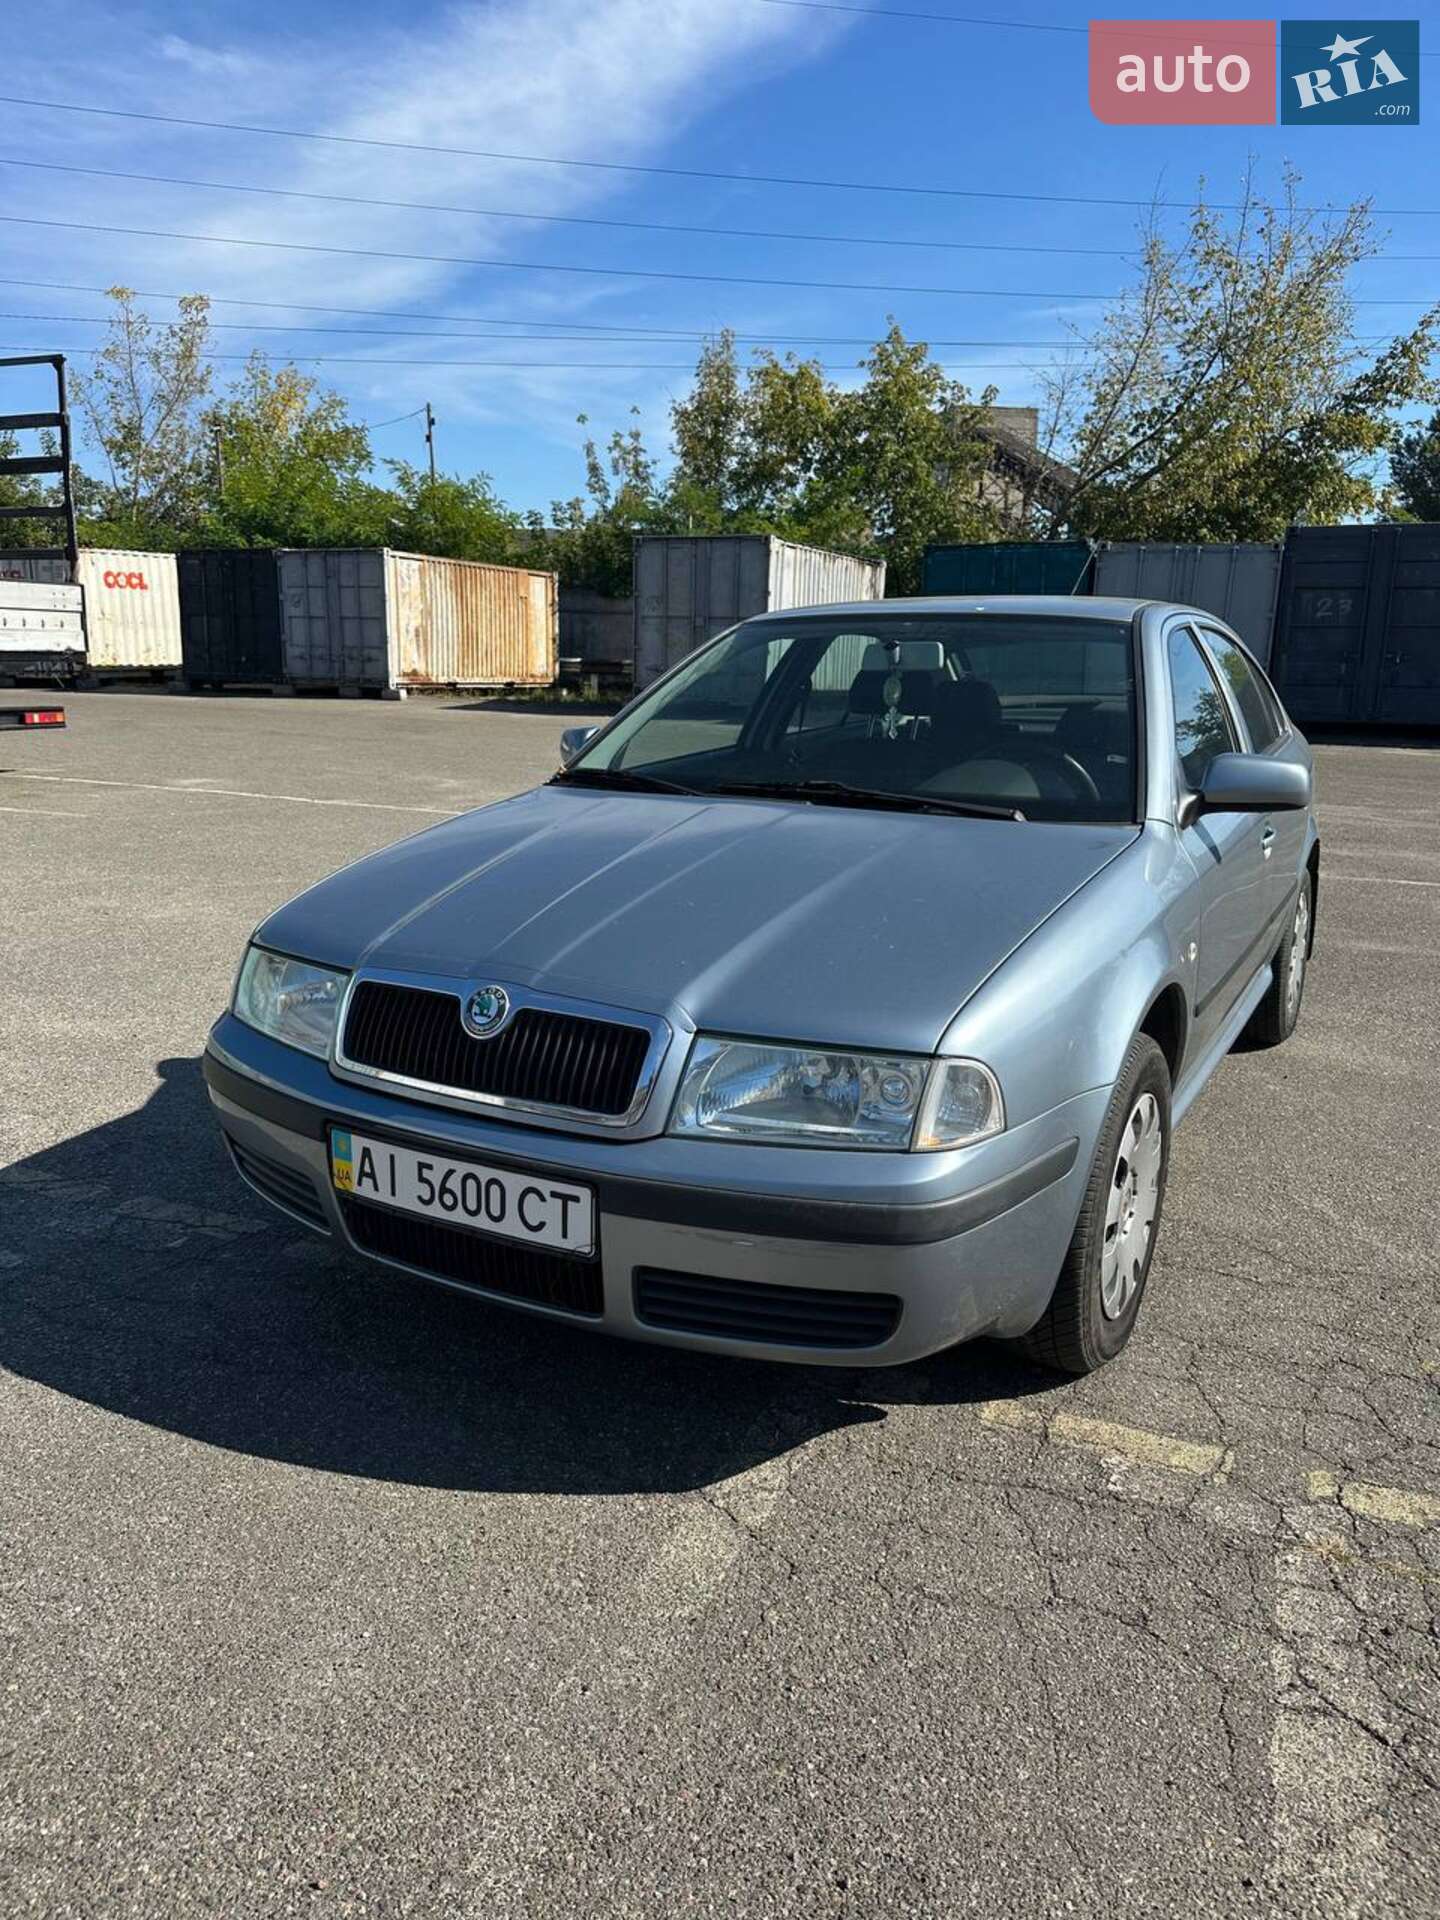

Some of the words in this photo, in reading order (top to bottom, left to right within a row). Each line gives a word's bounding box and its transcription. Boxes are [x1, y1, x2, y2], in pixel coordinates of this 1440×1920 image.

[357, 1146, 397, 1198] AI
[417, 1161, 506, 1223] 5600
[517, 1186, 581, 1240] CT
